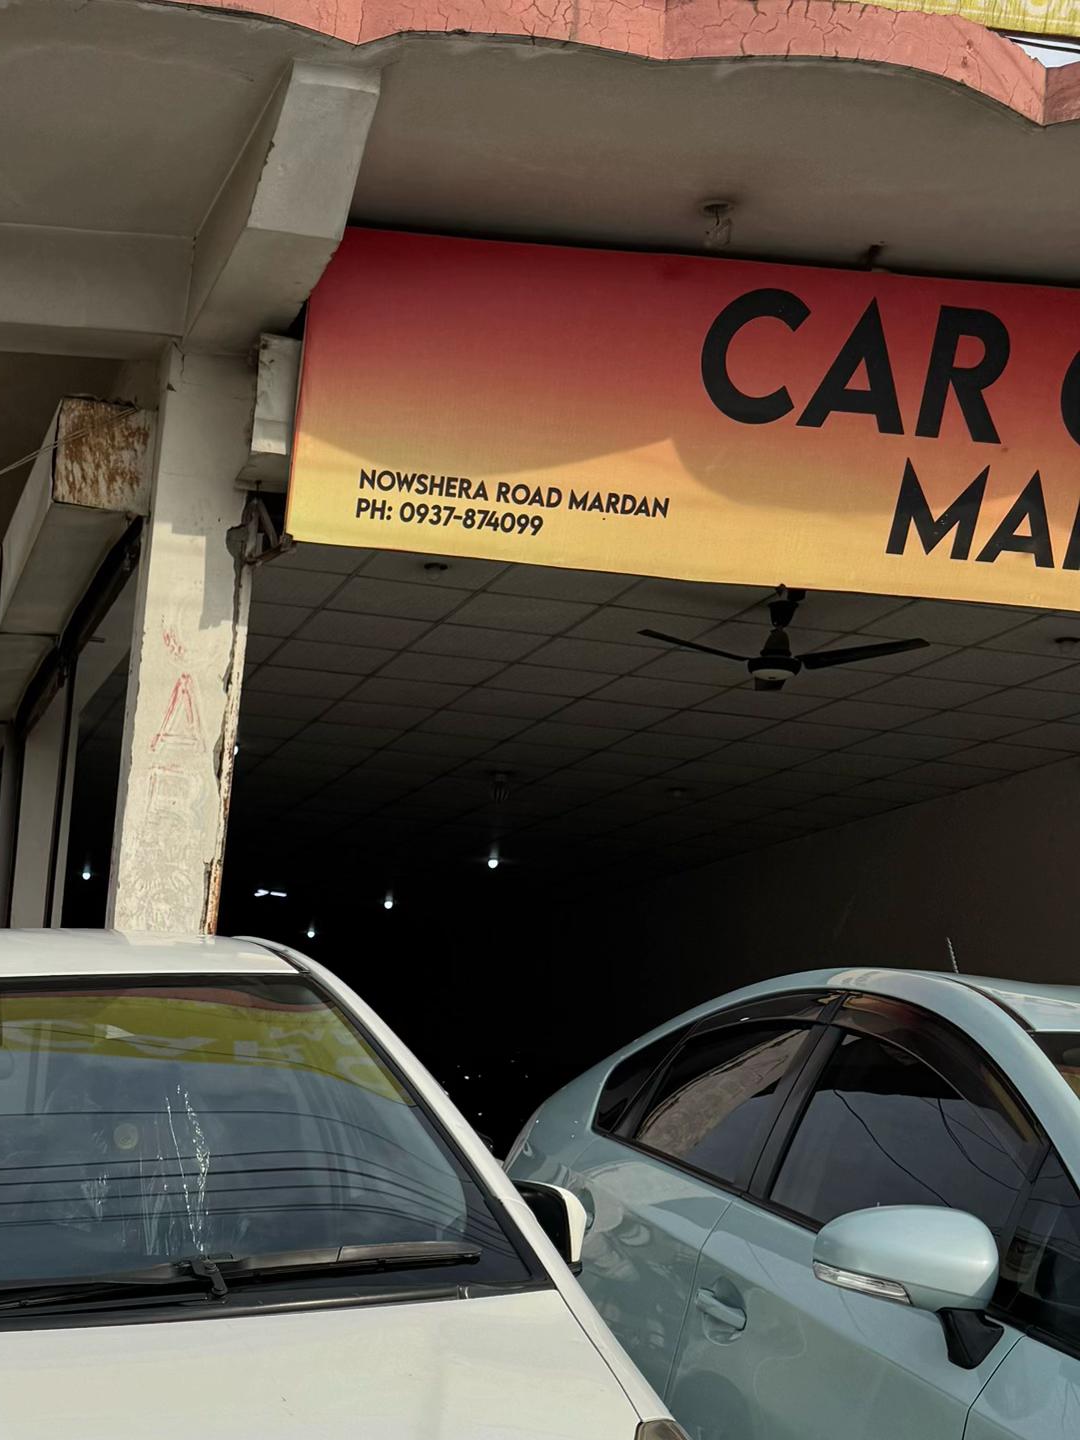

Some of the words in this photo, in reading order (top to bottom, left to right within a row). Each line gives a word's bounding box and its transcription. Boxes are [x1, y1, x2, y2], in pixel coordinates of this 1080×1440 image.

[701, 288, 1011, 445] CAR
[355, 498, 393, 521] PH:
[399, 502, 543, 536] 0937-874099
[359, 469, 489, 501] NOWSHERA
[496, 482, 562, 508] ROAD
[568, 489, 670, 518] MARDAN
[886, 457, 1080, 570] MA
